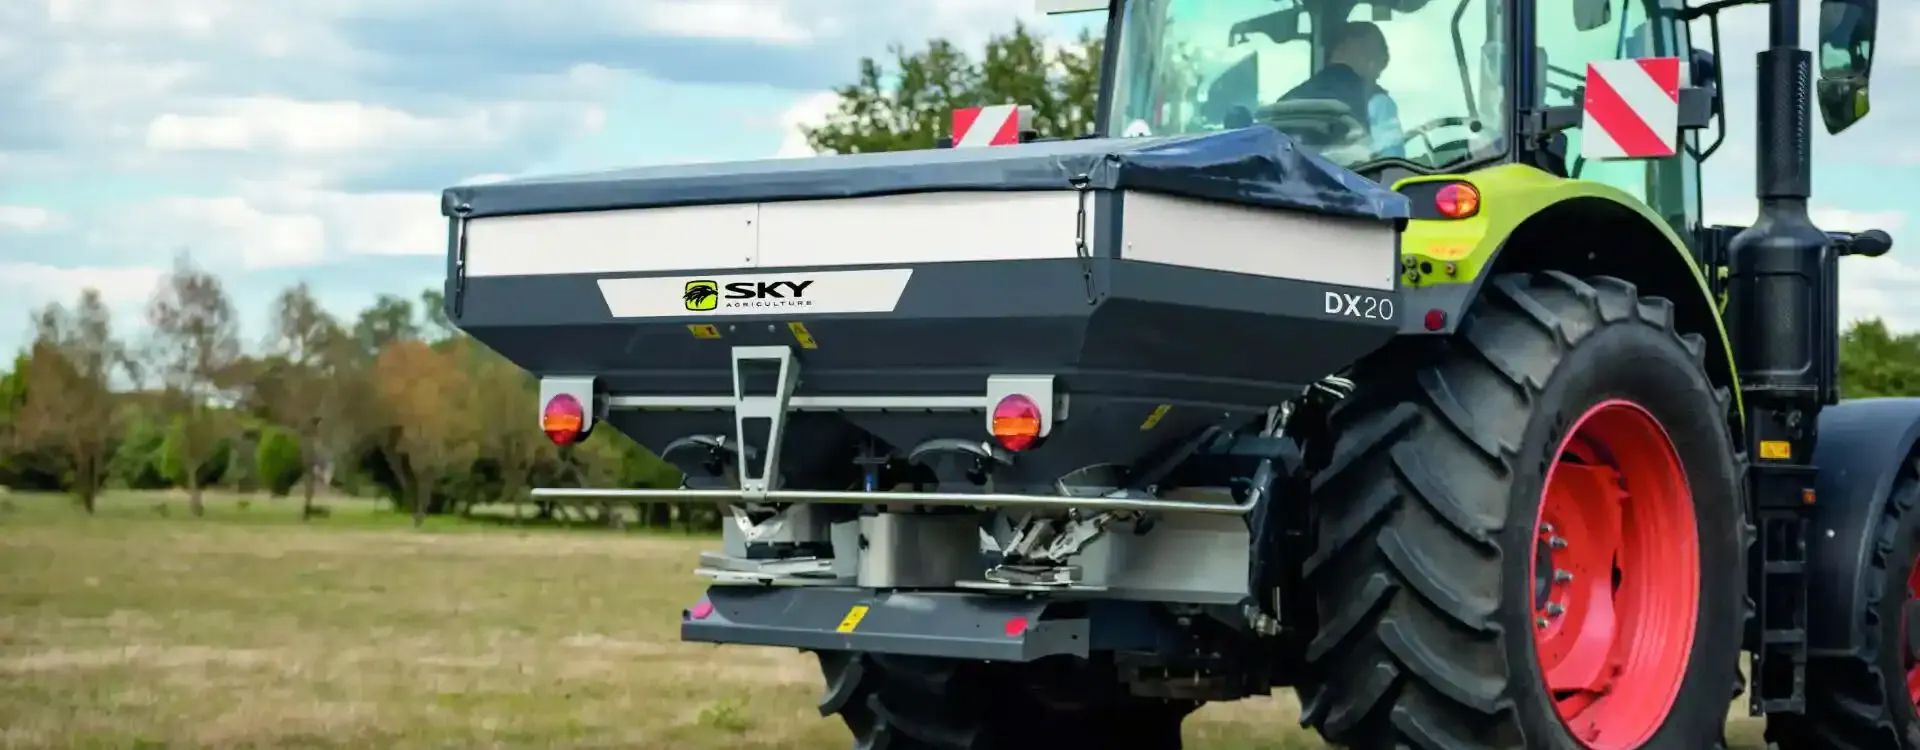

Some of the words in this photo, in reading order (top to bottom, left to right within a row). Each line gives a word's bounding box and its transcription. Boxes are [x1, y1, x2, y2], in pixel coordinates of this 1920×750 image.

[725, 280, 814, 299] SKY
[726, 300, 812, 308] AGRICULTURE
[1325, 291, 1394, 320] DX20
